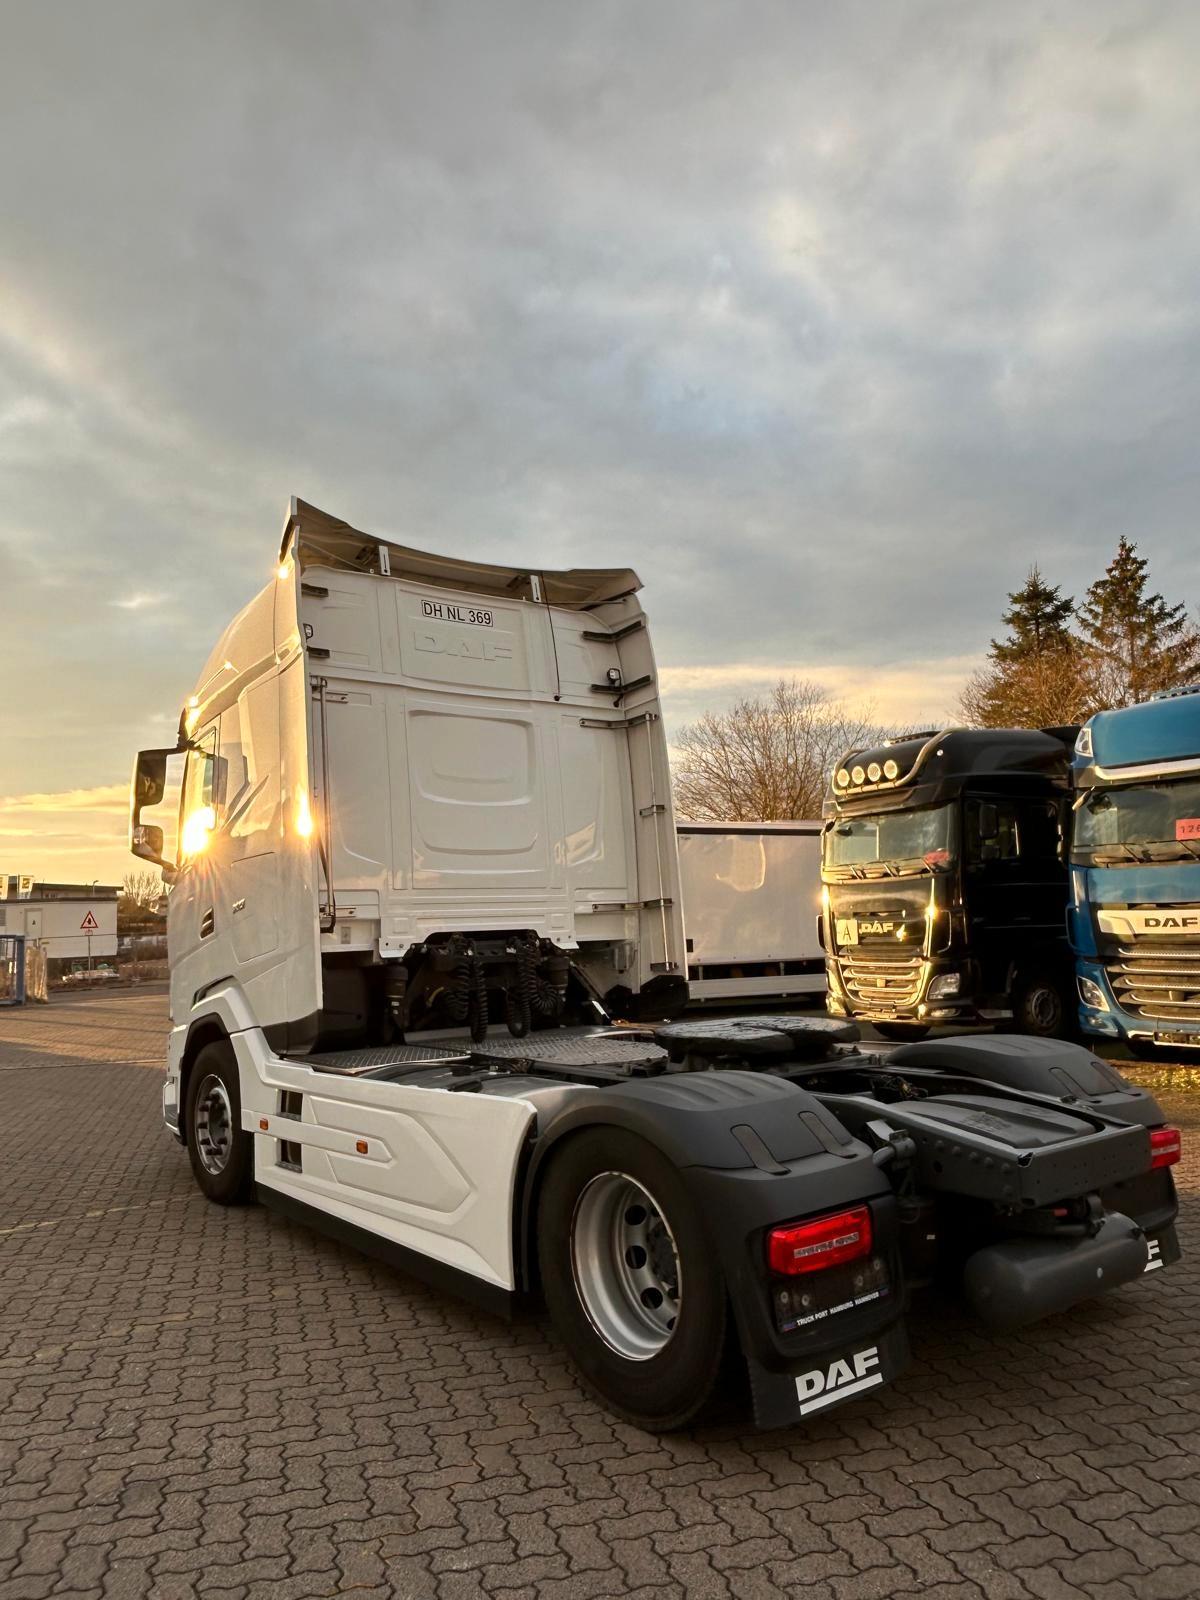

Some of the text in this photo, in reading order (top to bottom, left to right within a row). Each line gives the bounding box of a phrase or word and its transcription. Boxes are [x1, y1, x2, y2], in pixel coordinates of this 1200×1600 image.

[423, 602, 491, 625] DH NL 369
[413, 632, 512, 661] DAF
[859, 921, 894, 934] DAF
[1144, 917, 1198, 928] DAF
[843, 924, 852, 941] A
[797, 1315, 814, 1327] TRUCK
[815, 1310, 828, 1320] PORT
[795, 1347, 880, 1401] DAF
